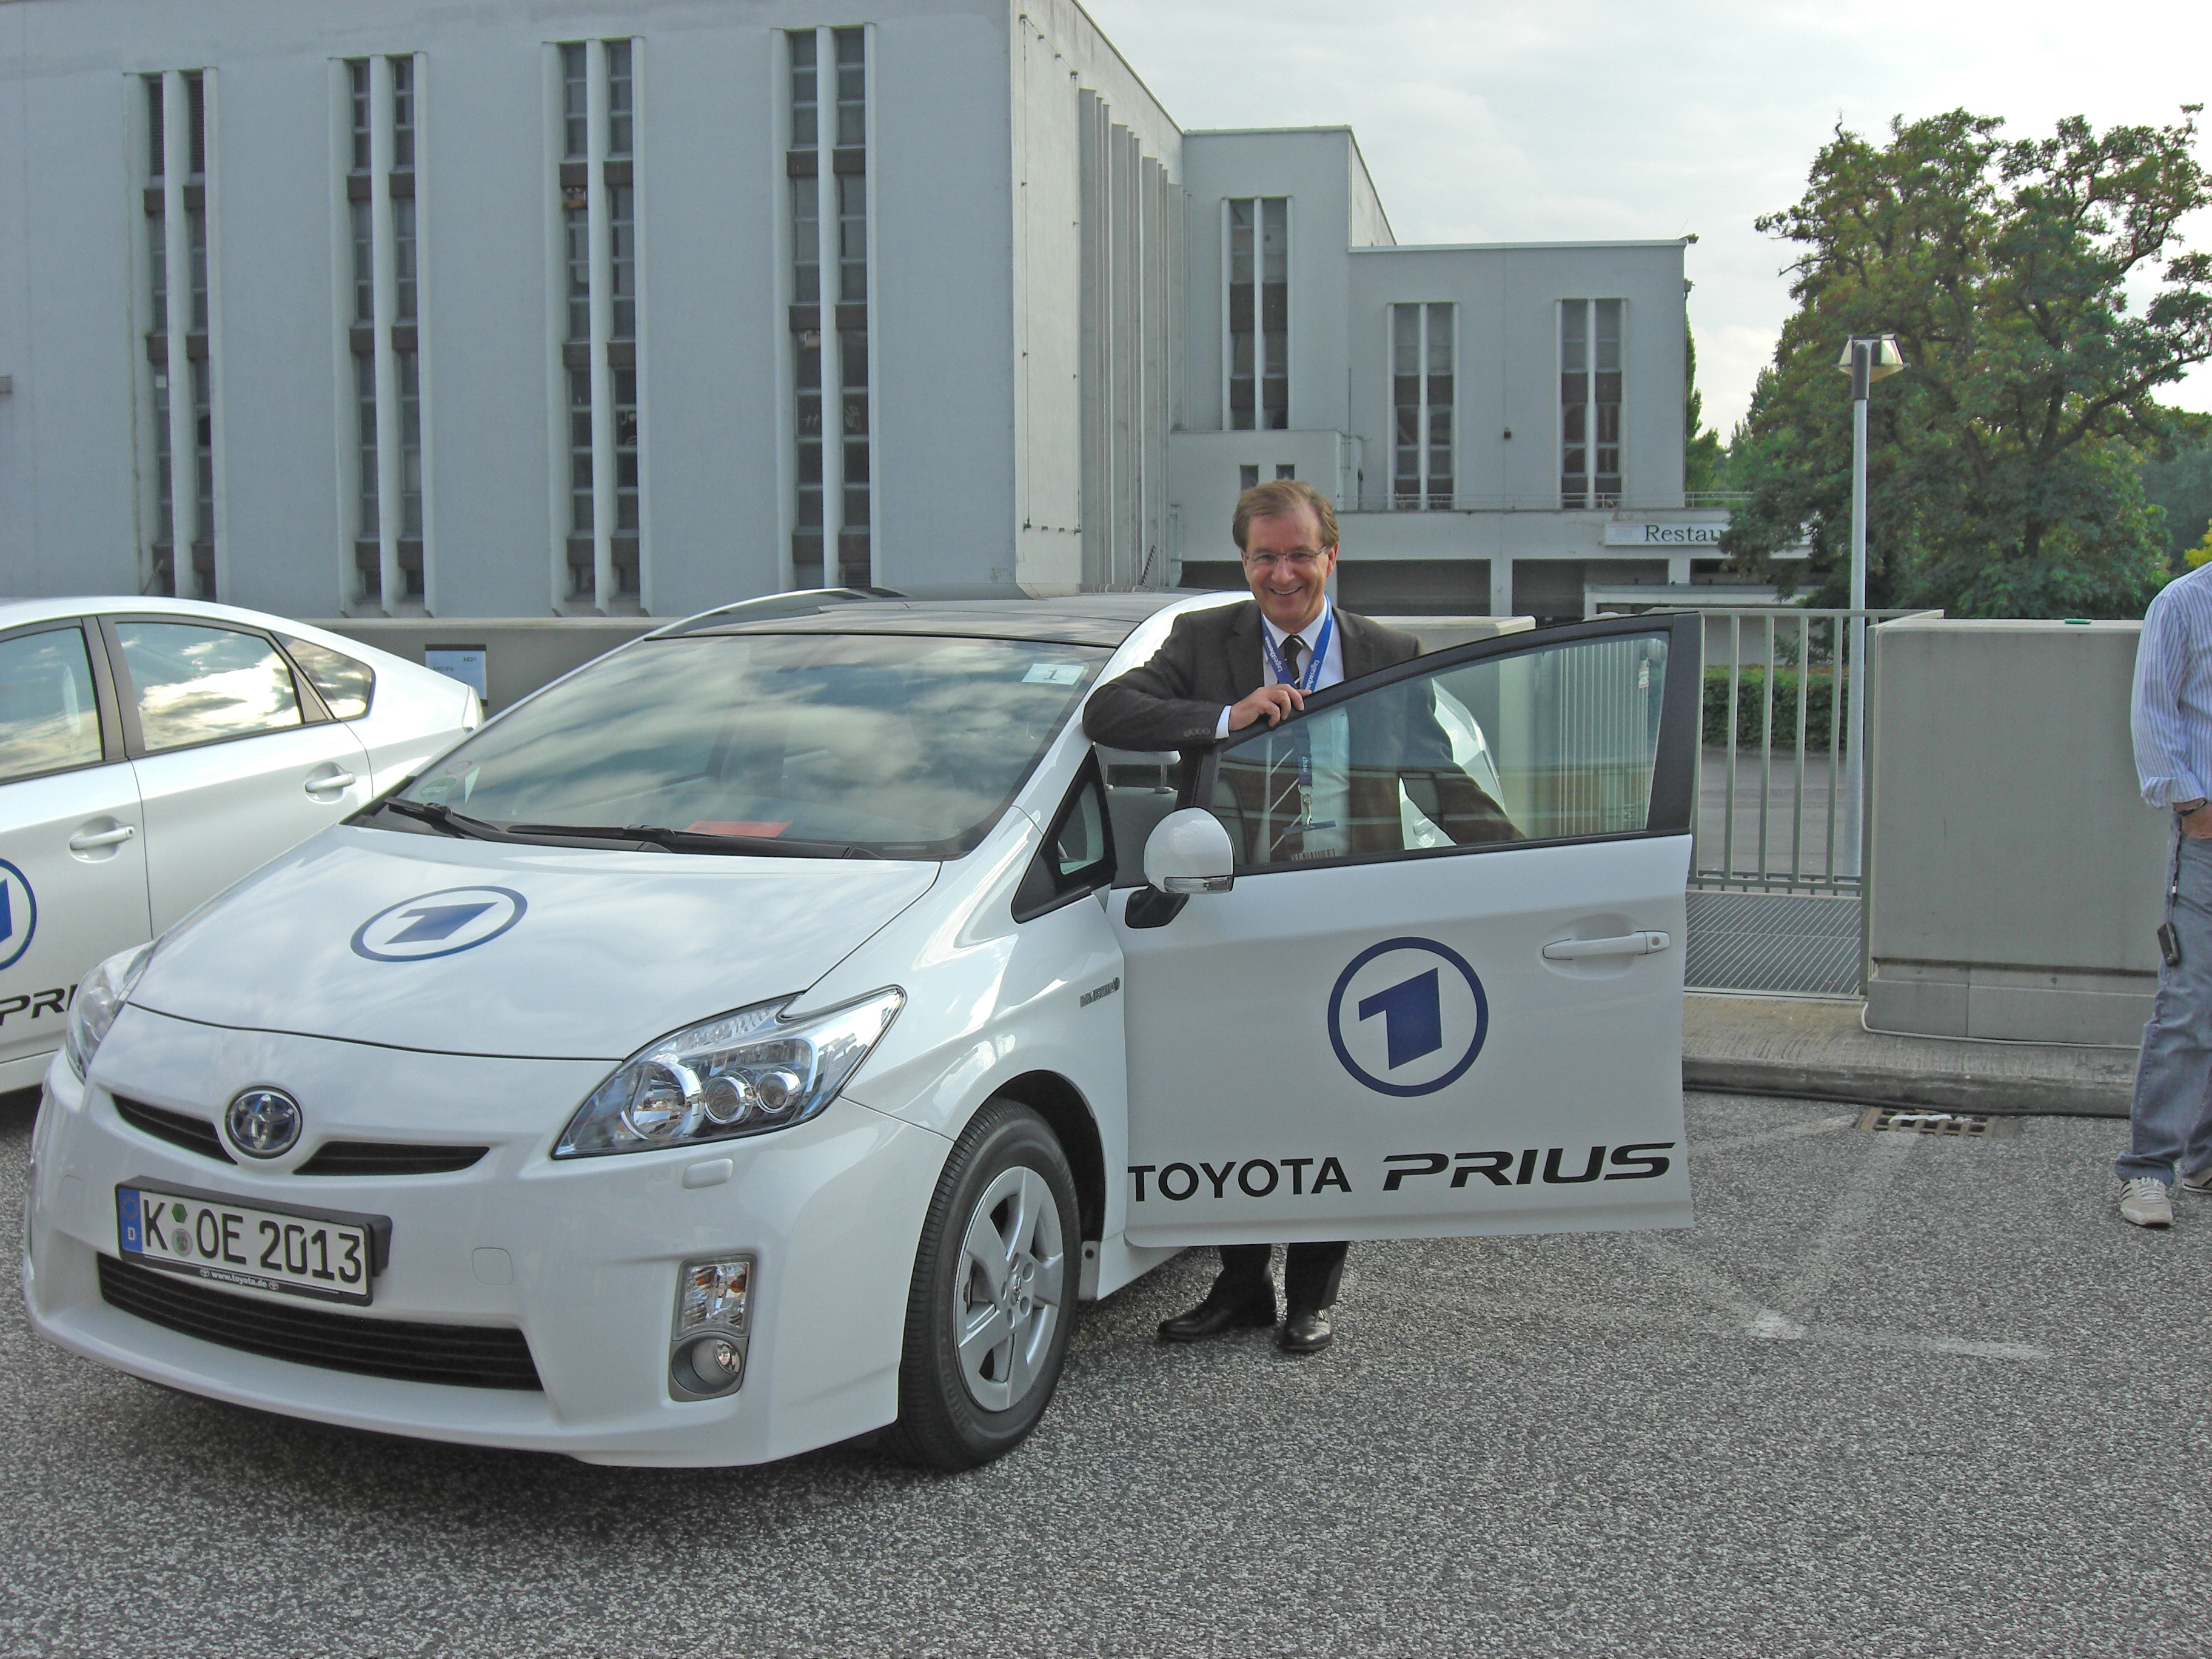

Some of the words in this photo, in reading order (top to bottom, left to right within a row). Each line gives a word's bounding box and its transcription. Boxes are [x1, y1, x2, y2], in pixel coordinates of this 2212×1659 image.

[1127, 1156, 1352, 1202] TOYOTA
[1382, 1142, 1676, 1191] PRIUS
[128, 1226, 136, 1241] D
[144, 1199, 168, 1250] K
[196, 1208, 247, 1265] OE
[258, 1219, 362, 1283] 2013
[211, 1271, 267, 1288] www.toyota.de
